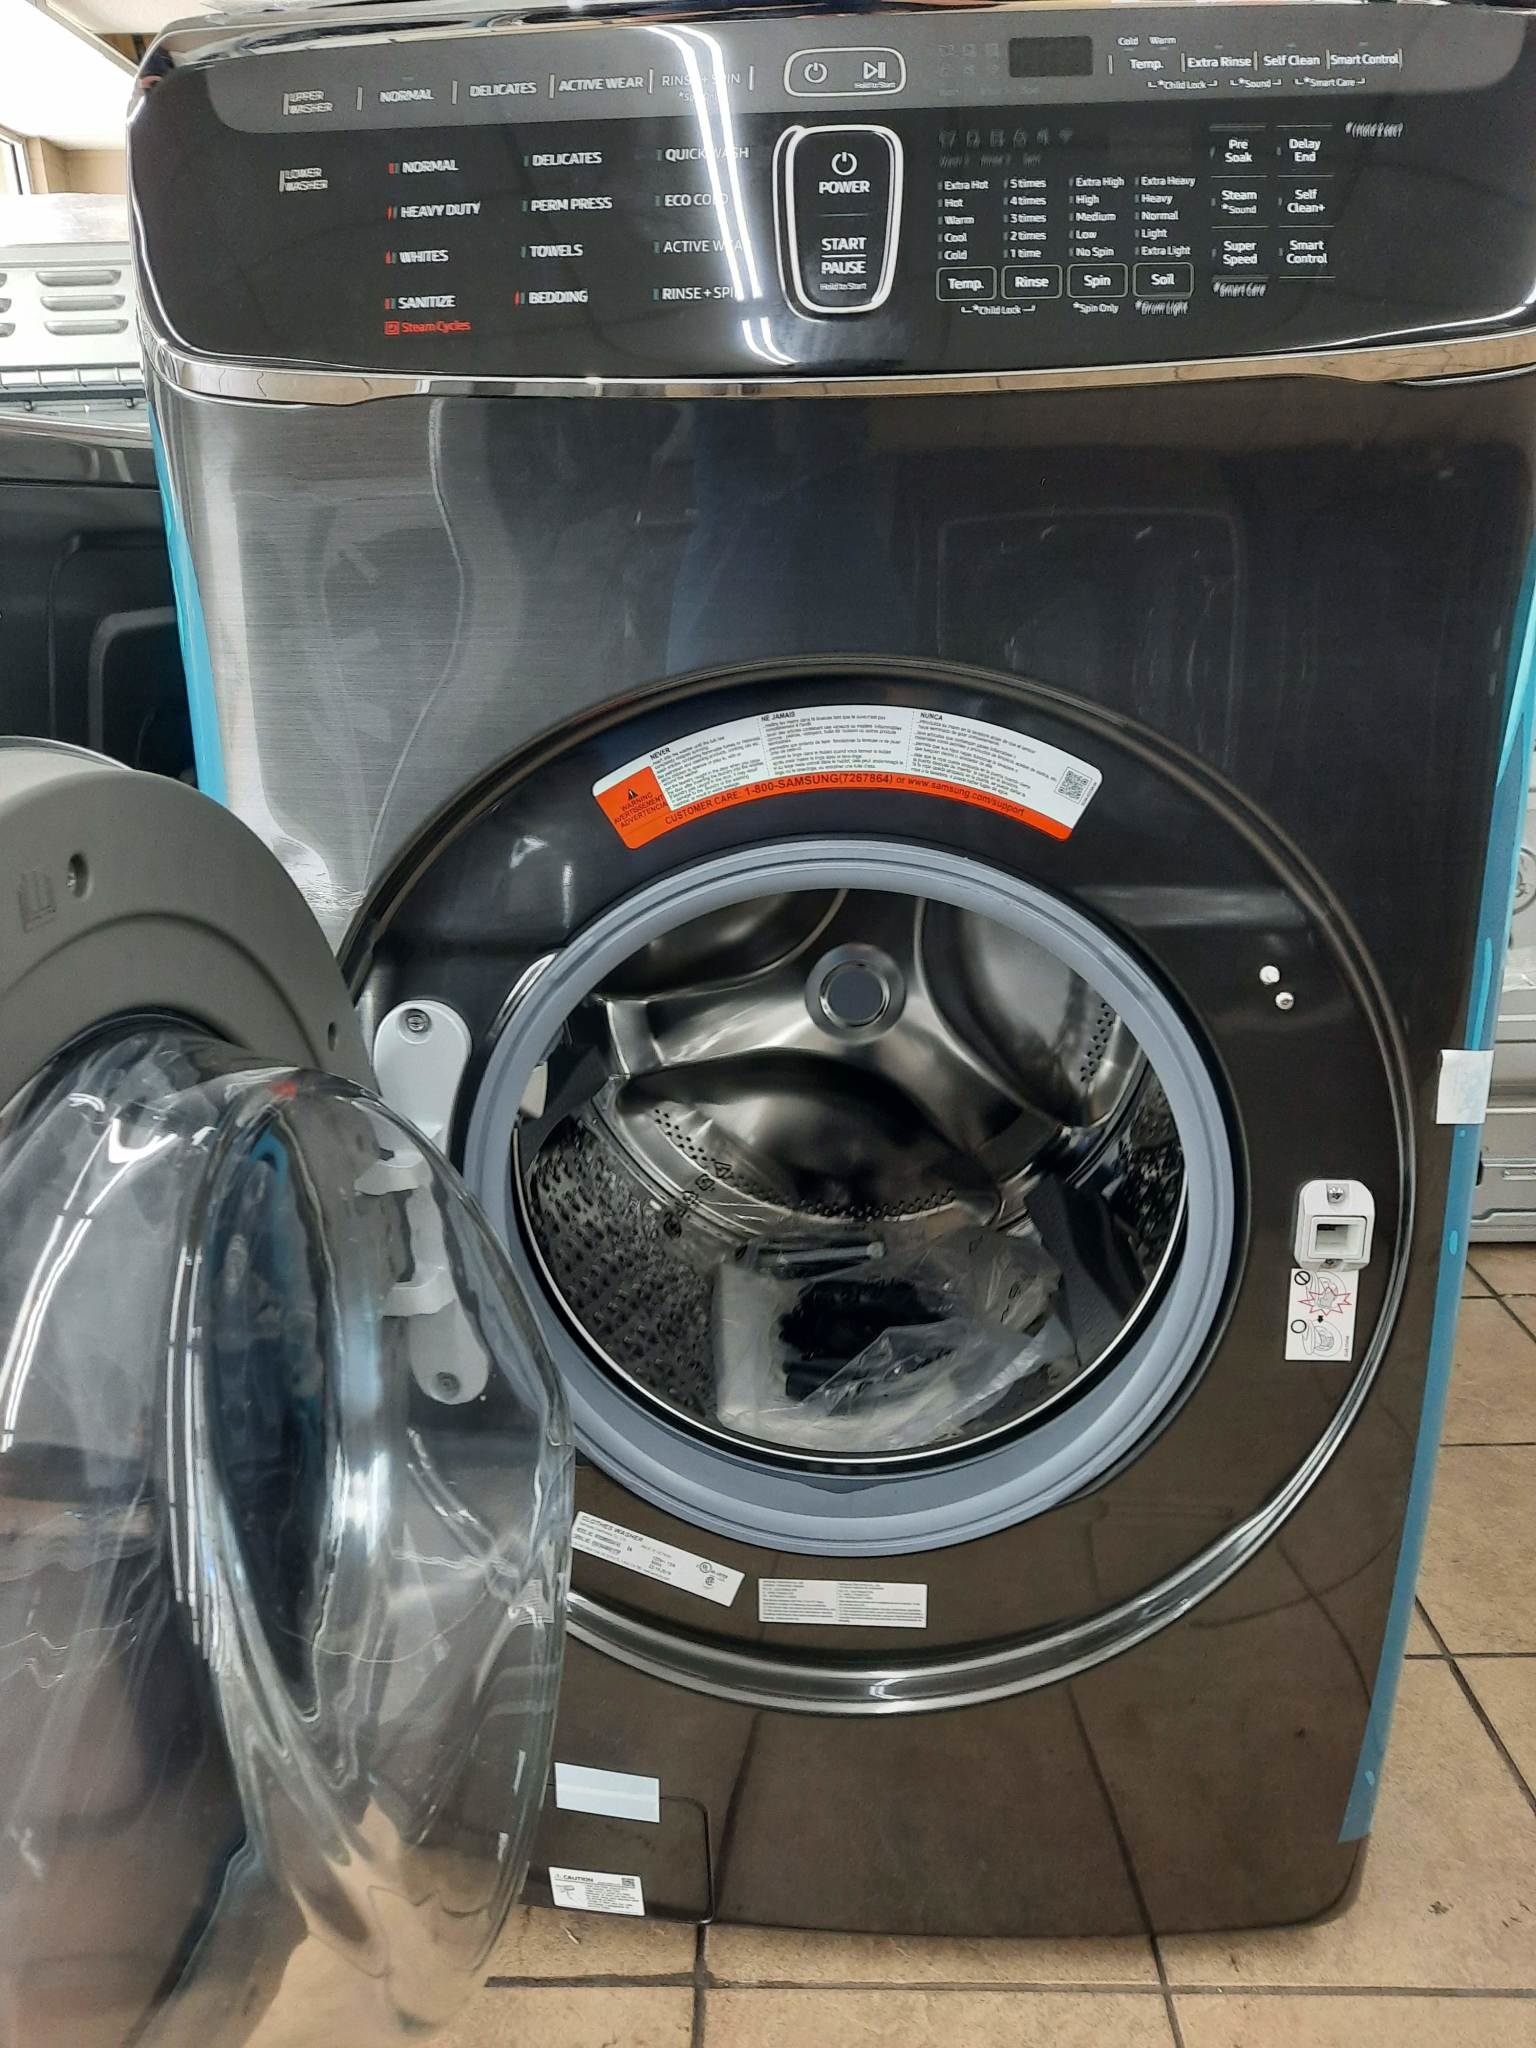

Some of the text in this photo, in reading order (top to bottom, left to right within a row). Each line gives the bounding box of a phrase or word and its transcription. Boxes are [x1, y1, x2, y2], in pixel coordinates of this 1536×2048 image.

[1117, 37, 1139, 46] Cold
[1149, 36, 1177, 45] Warm
[1130, 59, 1164, 70] Temp.
[1187, 56, 1252, 68] Extra Rinse
[1263, 55, 1320, 66] Self Clean
[1330, 54, 1399, 66] Smart Control
[559, 77, 644, 92] ACTIVE WEAR
[662, 75, 698, 86] RINS
[1186, 80, 1207, 90] Lock
[1336, 78, 1356, 87] Care
[379, 89, 435, 102] NORMAL
[470, 82, 537, 97] DELICATES
[1229, 139, 1248, 149] Pre
[1289, 138, 1321, 150] Delay
[532, 152, 602, 166] DELICATES
[1225, 152, 1252, 163] Soak
[1295, 151, 1316, 162] End
[402, 160, 460, 173] NORMAL
[818, 180, 870, 194] POWER
[944, 180, 989, 191] Extra Hot
[1010, 178, 1046, 189] 5 times
[1076, 177, 1124, 188] Extra High
[1141, 176, 1195, 187] Extra Heavy
[664, 192, 729, 207] ECO COD
[1010, 195, 1046, 206] 4 times
[1076, 195, 1100, 206] High
[1141, 194, 1173, 205] Heavy
[1221, 189, 1257, 201] Steam
[1294, 189, 1318, 200] Self
[531, 197, 613, 212] PERM PRESS
[944, 198, 964, 208] Hot
[1287, 202, 1326, 213] Clean+
[401, 201, 481, 218] HEAVY DUTY
[944, 215, 974, 225] Warm
[1010, 213, 1047, 223] 3 times
[1076, 211, 1116, 222] Medium
[1141, 211, 1179, 221] Normal
[944, 232, 967, 243] Cool
[1010, 230, 1047, 241] 2 times
[1076, 229, 1097, 239] Low
[1141, 228, 1168, 240] Light
[663, 239, 710, 253] ACTIVE
[821, 237, 868, 251] START
[1223, 240, 1257, 253] Super
[1289, 239, 1324, 251] Smart
[399, 250, 449, 263] WHITES
[530, 244, 583, 258] TOWELS
[944, 249, 968, 260] Cold
[1010, 248, 1041, 259] 1 time
[1076, 247, 1114, 259] No Spin
[1141, 246, 1191, 258] Extra Light
[1223, 253, 1257, 266] Speed
[1286, 252, 1328, 264] Control
[821, 260, 867, 275] PAUSE
[948, 277, 984, 291] Temp.
[1014, 276, 1049, 288] Rinse
[1083, 274, 1111, 288] Spin
[1151, 273, 1175, 286] Soil
[847, 282, 867, 290] Start
[528, 290, 588, 304] BEDDING
[662, 287, 702, 300] RINSE
[703, 288, 712, 297] +
[398, 295, 456, 309] SANITIZE
[1098, 302, 1119, 314] Only
[1002, 304, 1021, 315] Lock
[401, 320, 471, 333] Steam Cycles
[920, 712, 943, 721] NUNCA
[650, 747, 671, 760] NEVER
[665, 797, 713, 825] CUSTOMER
